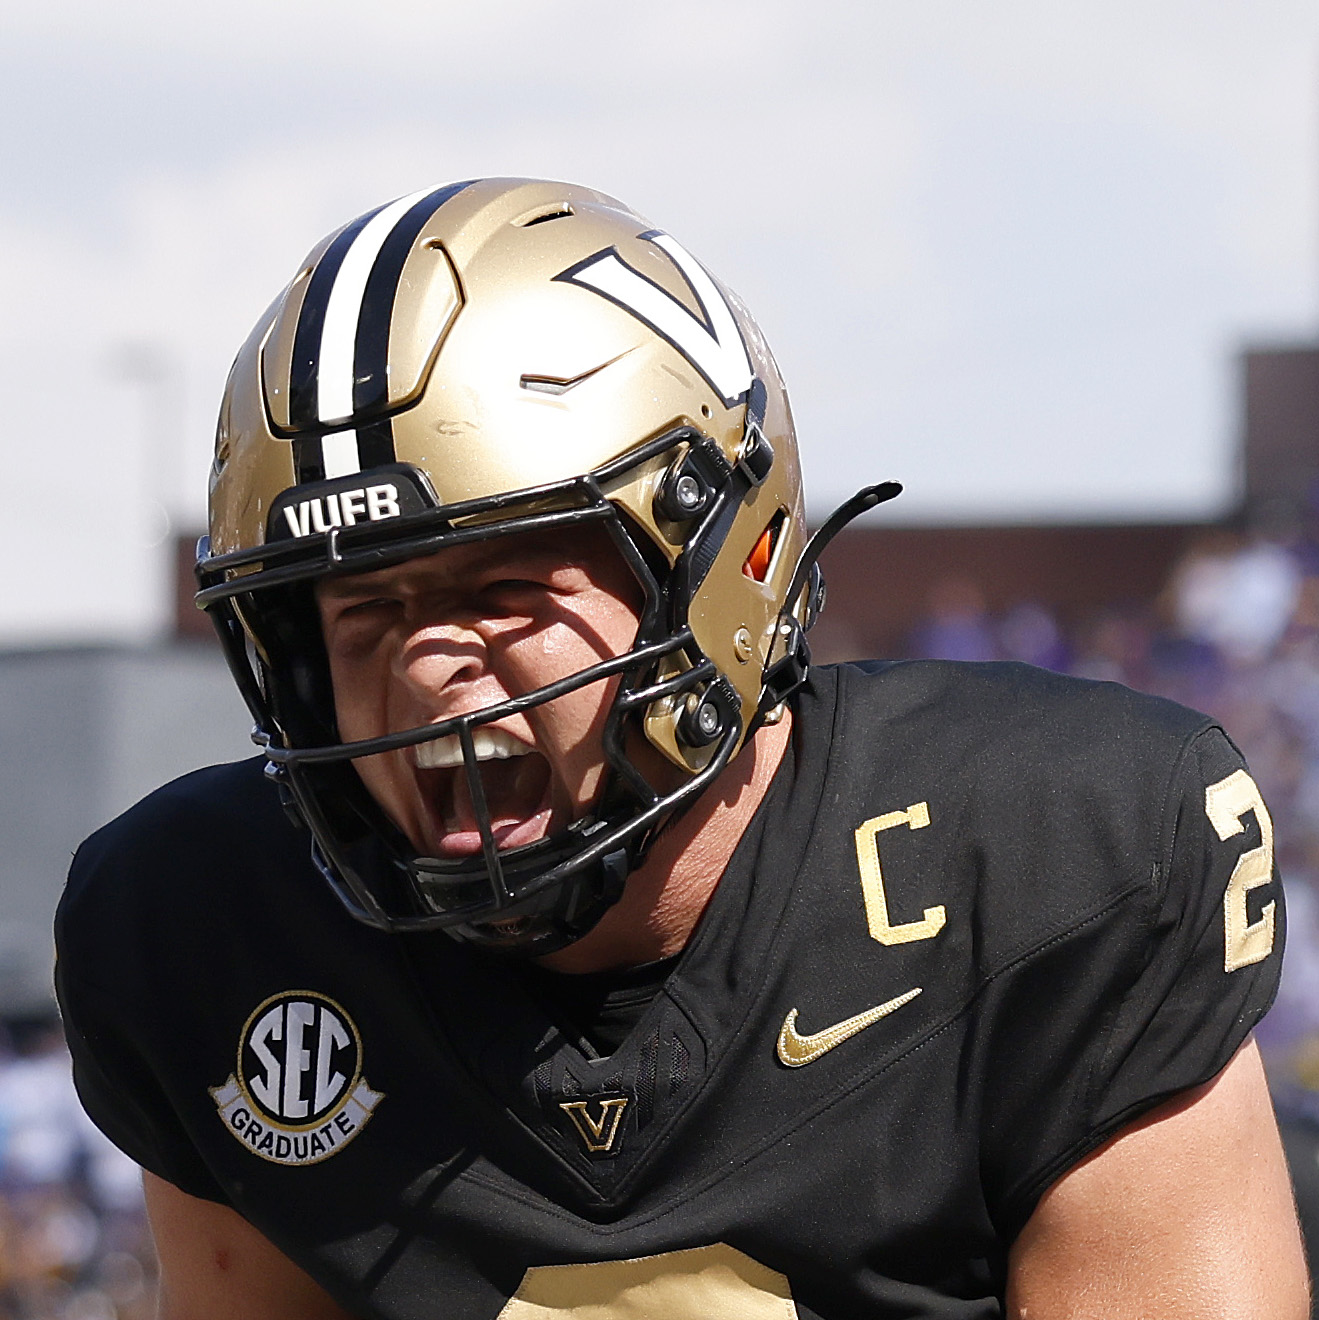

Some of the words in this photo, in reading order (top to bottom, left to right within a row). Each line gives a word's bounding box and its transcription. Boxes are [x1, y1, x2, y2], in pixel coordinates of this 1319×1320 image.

[550, 229, 755, 411] V
[283, 483, 401, 538] VUFB
[855, 801, 946, 946] C
[1205, 768, 1277, 973] 2
[248, 1001, 351, 1119] SEC
[230, 1107, 356, 1159] GRADUATE
[559, 1097, 629, 1152] V
